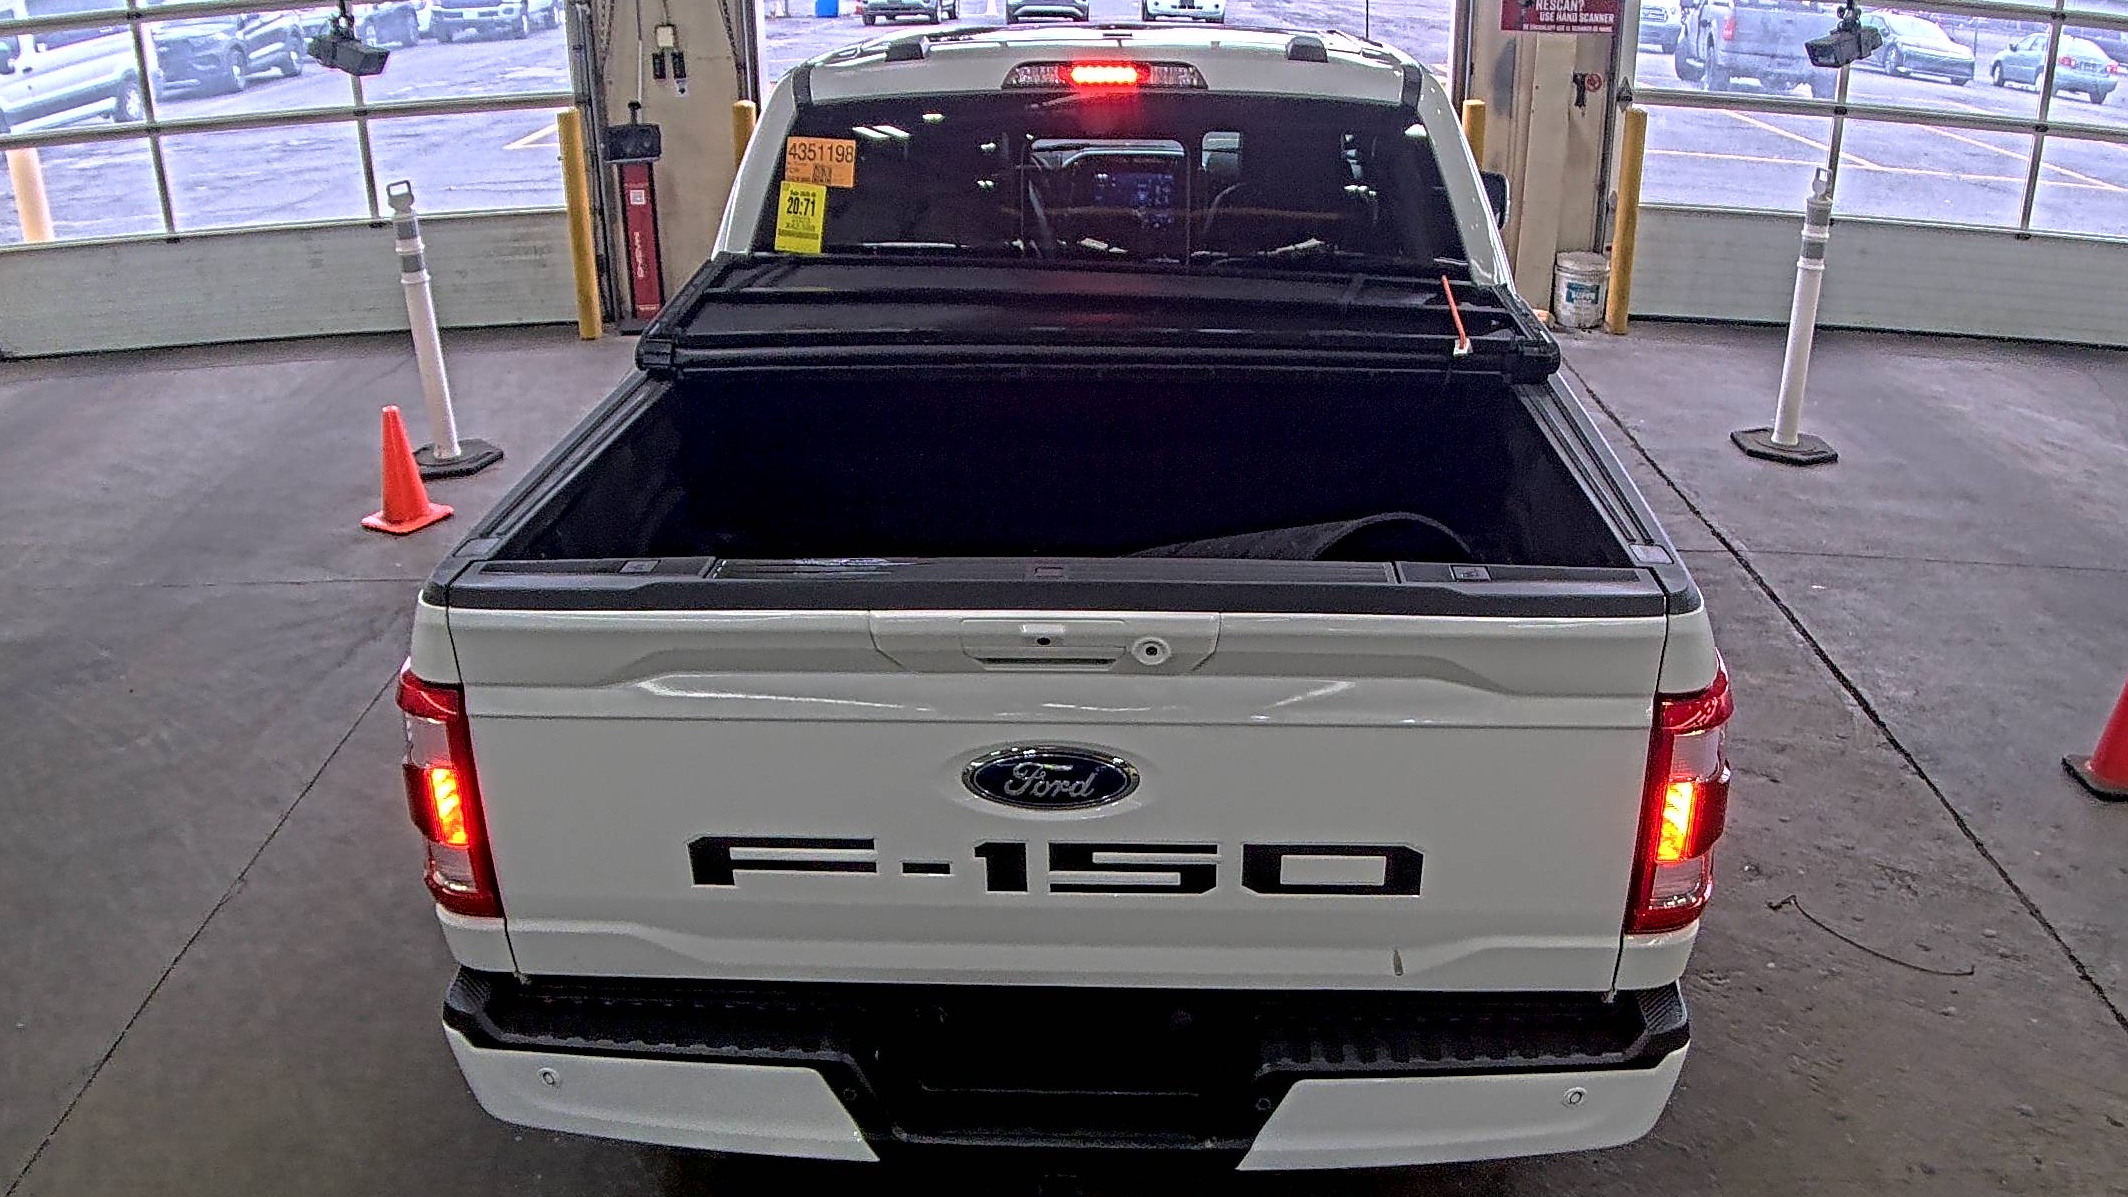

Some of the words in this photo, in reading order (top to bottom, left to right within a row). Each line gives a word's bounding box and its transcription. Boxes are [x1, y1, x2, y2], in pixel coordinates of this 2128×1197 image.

[1536, 0, 1585, 11] RESCAN?
[1539, 11, 1555, 22] USE
[1556, 11, 1578, 22] HAND
[1578, 12, 1615, 23] SCANNER
[788, 142, 854, 163] 4351198
[786, 196, 816, 217] 20:71
[1004, 761, 1099, 798] Ford
[686, 836, 1424, 897] F-150
